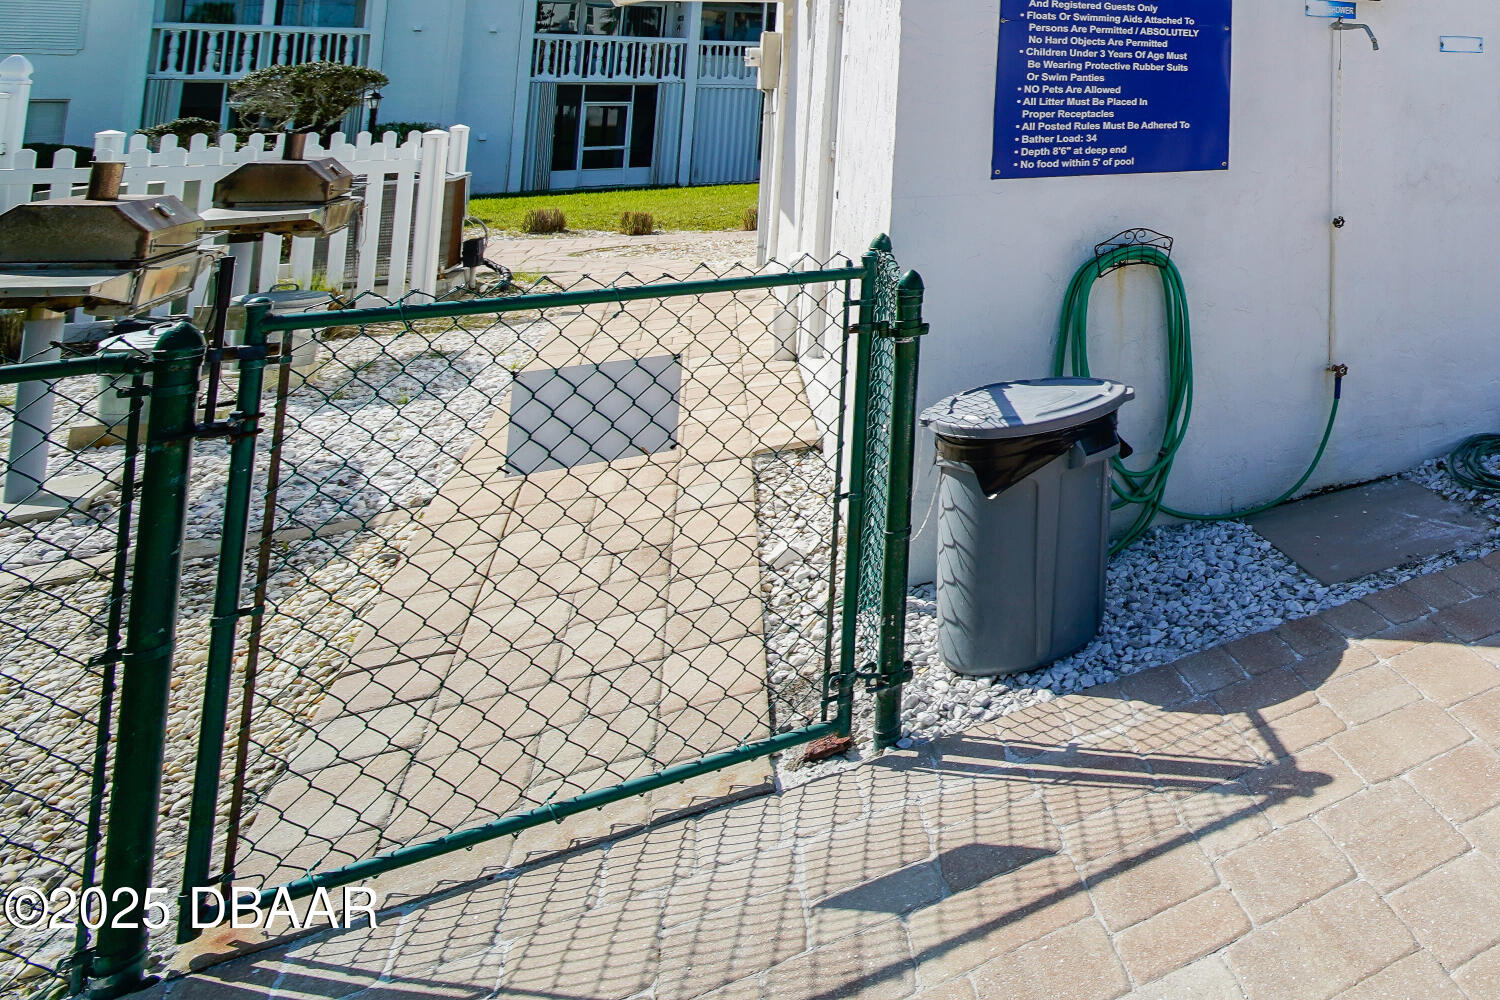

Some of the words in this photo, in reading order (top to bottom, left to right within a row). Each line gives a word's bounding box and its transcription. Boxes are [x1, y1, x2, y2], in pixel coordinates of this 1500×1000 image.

[1029, 0, 1048, 8] And
[1051, 0, 1101, 12] Registered
[1104, 2, 1135, 11] Guests
[1137, 4, 1158, 13] Only
[1026, 12, 1056, 21] Floats
[1058, 13, 1070, 21] Or
[1073, 13, 1120, 24] Swimming
[1123, 15, 1142, 24] Aids
[1144, 16, 1182, 25] Attached
[1184, 17, 1195, 25] To
[1029, 24, 1068, 33] Persons
[1070, 25, 1087, 33] Are
[1090, 26, 1133, 35] Permitted
[1140, 27, 1199, 37] ABSOLUTELY
[1029, 36, 1042, 44] No
[1045, 36, 1068, 45] Hard
[1070, 37, 1105, 47] Objects
[1108, 38, 1123, 46] Are
[1126, 39, 1168, 48] Permitted
[1026, 48, 1067, 57] Children
[1069, 49, 1098, 58] Under
[1108, 50, 1133, 59] Years
[1135, 51, 1145, 59] Of
[1147, 51, 1164, 60] Age
[1166, 52, 1188, 60] Must
[1028, 60, 1041, 68] Be
[1043, 61, 1082, 70] Wearing
[1085, 62, 1130, 70] Protective
[1133, 63, 1164, 71] Rubber
[1166, 63, 1188, 72] Suits
[1026, 73, 1039, 81] Or
[1042, 73, 1067, 81] Swim
[1070, 73, 1104, 82] Panties
[1024, 85, 1040, 94] NO
[1043, 86, 1064, 94] Pets
[1066, 86, 1082, 94] Are
[1085, 86, 1121, 94] Allowed
[1023, 97, 1037, 105] All
[1039, 98, 1065, 106] Litter
[1067, 98, 1090, 106] Must
[1107, 98, 1137, 106] Placed
[1139, 98, 1148, 106] In
[1022, 110, 1055, 120] Proper
[1058, 110, 1114, 119] Receptacles
[1022, 122, 1035, 130] All
[1038, 122, 1071, 131] Posted
[1074, 122, 1100, 130] Rules
[1103, 121, 1125, 130] Must
[1127, 121, 1139, 129] Be
[1141, 121, 1177, 129] Adhered
[1180, 121, 1190, 129] To
[1022, 135, 1054, 143] Bather
[1056, 135, 1083, 143] Load:
[1086, 134, 1097, 142] 34
[1021, 147, 1050, 157] Depth
[1085, 146, 1107, 157] deep
[1110, 146, 1127, 154] end
[1020, 160, 1034, 169] No
[1037, 159, 1059, 168] food
[1061, 159, 1091, 167] within
[1103, 158, 1112, 167] of
[1114, 157, 1134, 167] pool
